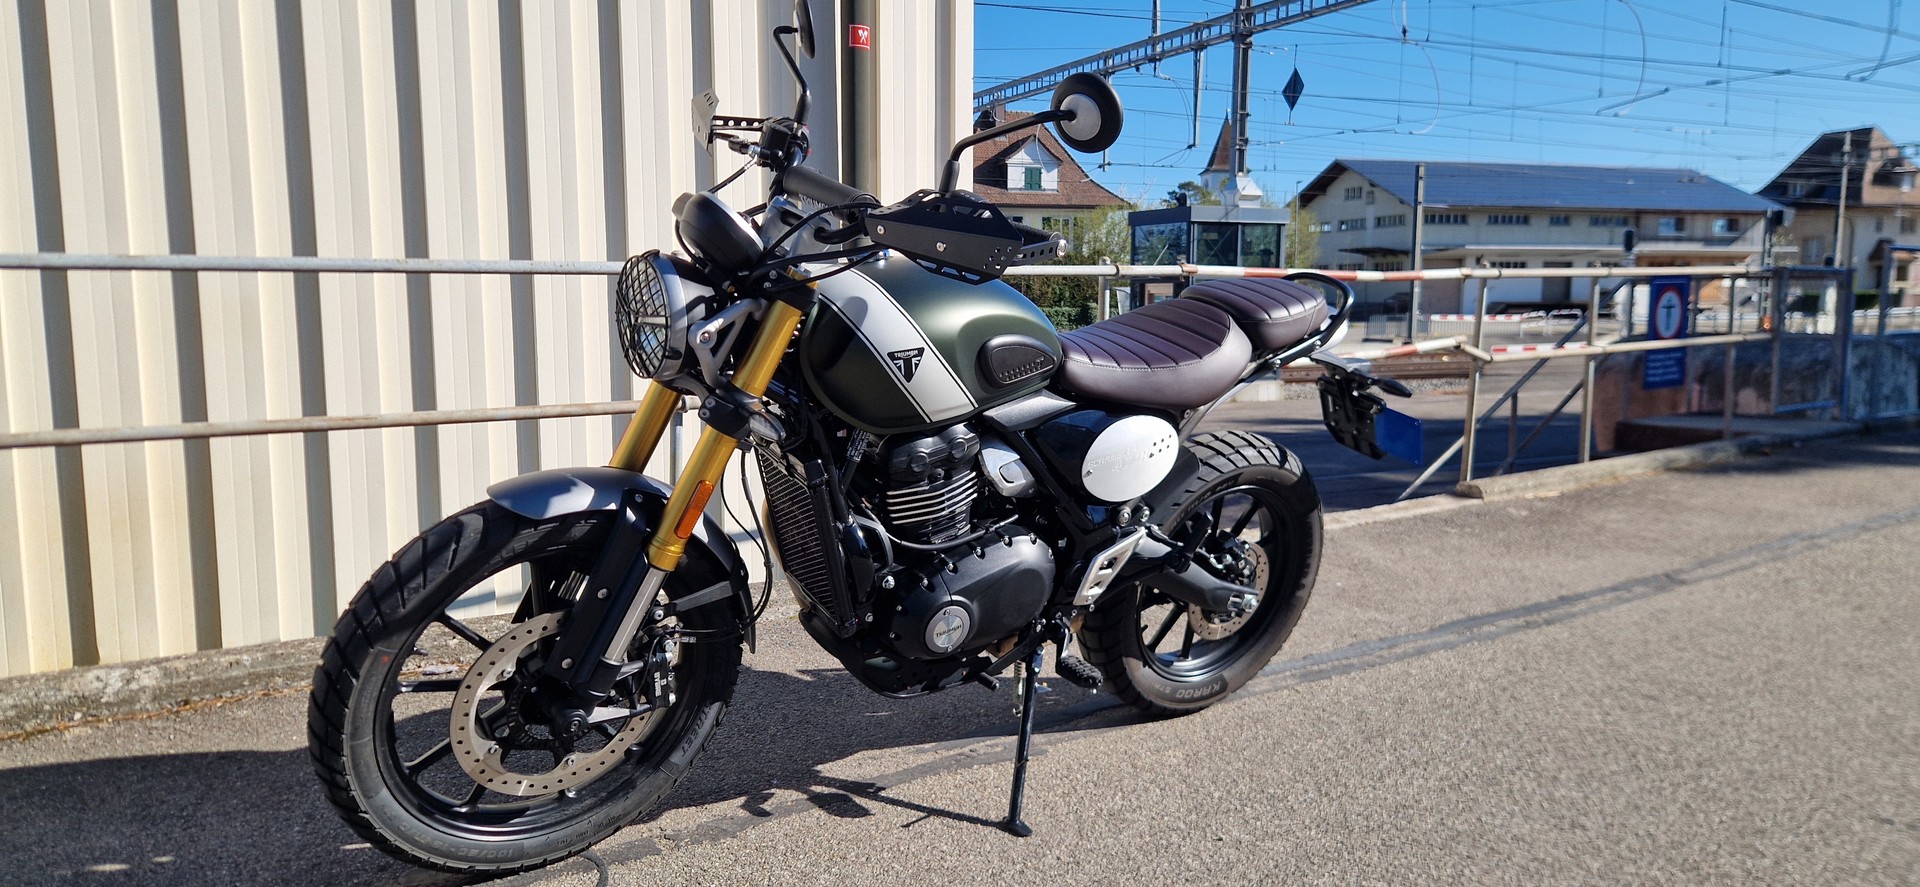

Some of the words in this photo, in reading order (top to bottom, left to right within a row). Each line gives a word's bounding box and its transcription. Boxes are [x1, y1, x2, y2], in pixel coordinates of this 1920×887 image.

[894, 349, 919, 358] TRIUMPH
[935, 624, 962, 638] TRIUMPH
[1175, 680, 1222, 699] KAROO
